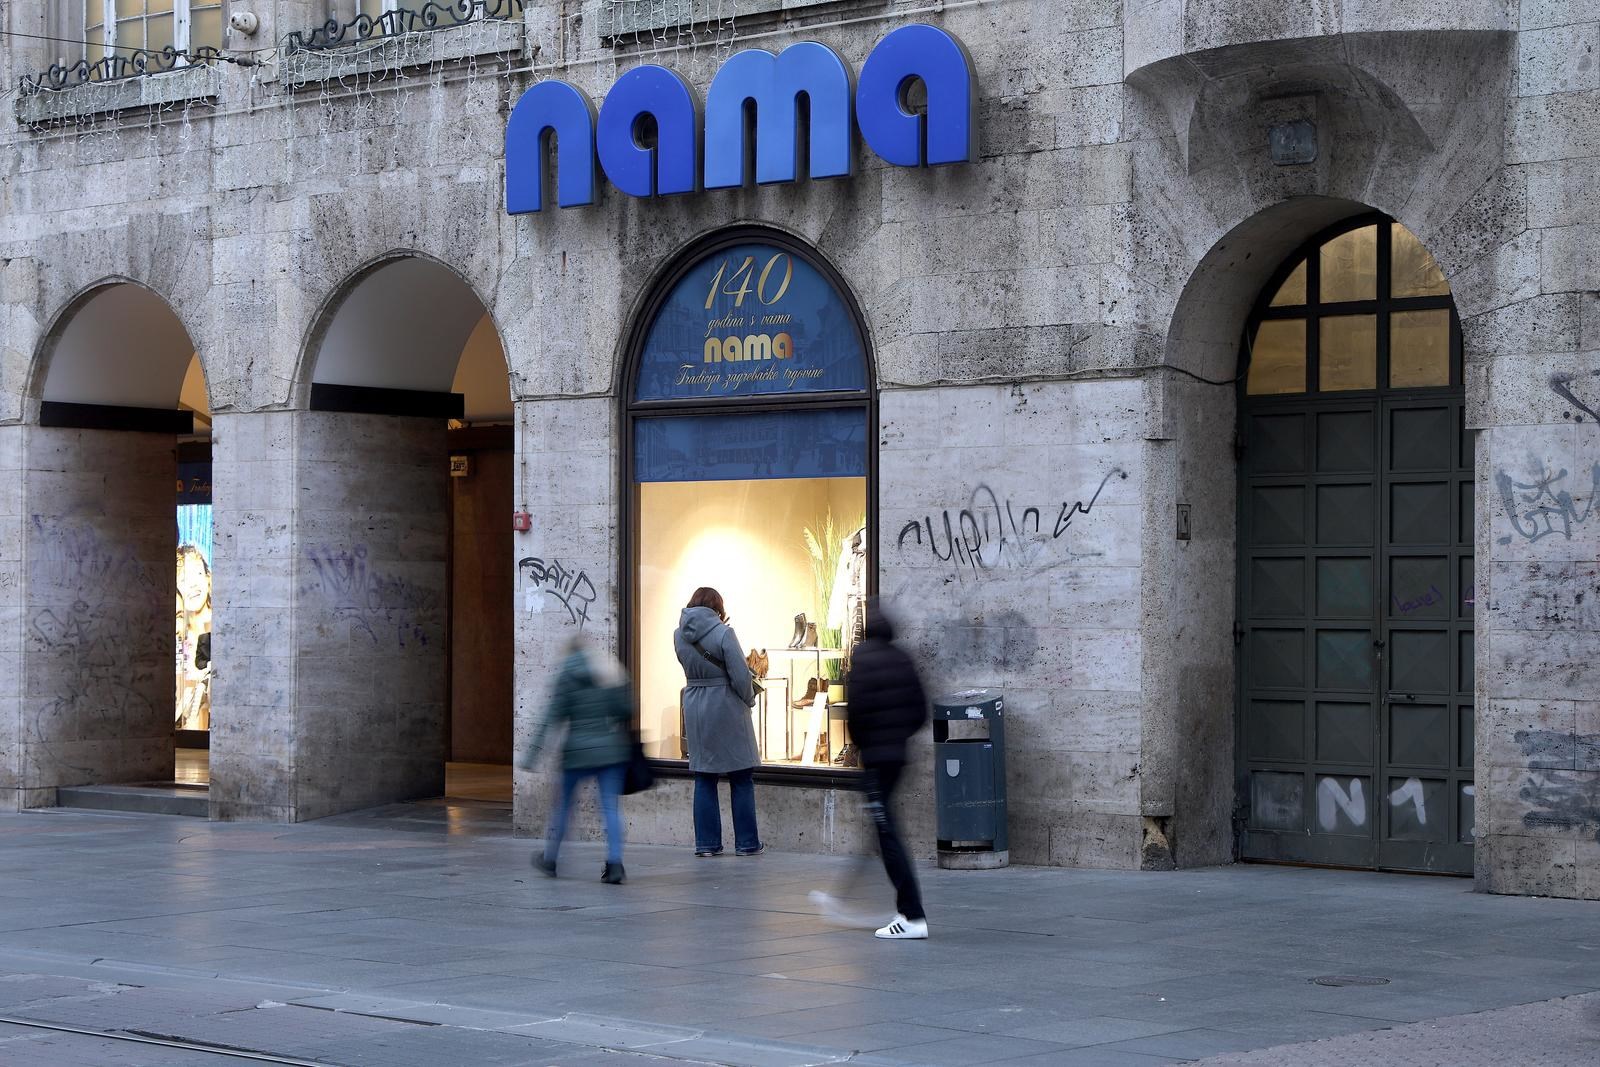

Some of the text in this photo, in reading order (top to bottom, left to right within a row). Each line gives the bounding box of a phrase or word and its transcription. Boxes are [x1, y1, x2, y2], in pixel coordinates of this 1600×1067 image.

[505, 23, 976, 215] nama
[704, 252, 793, 310] 140
[703, 310, 744, 338] godina
[761, 313, 792, 326] vama
[703, 332, 794, 363] nama
[675, 360, 824, 392] Tradicija zagrebačke trgovine
